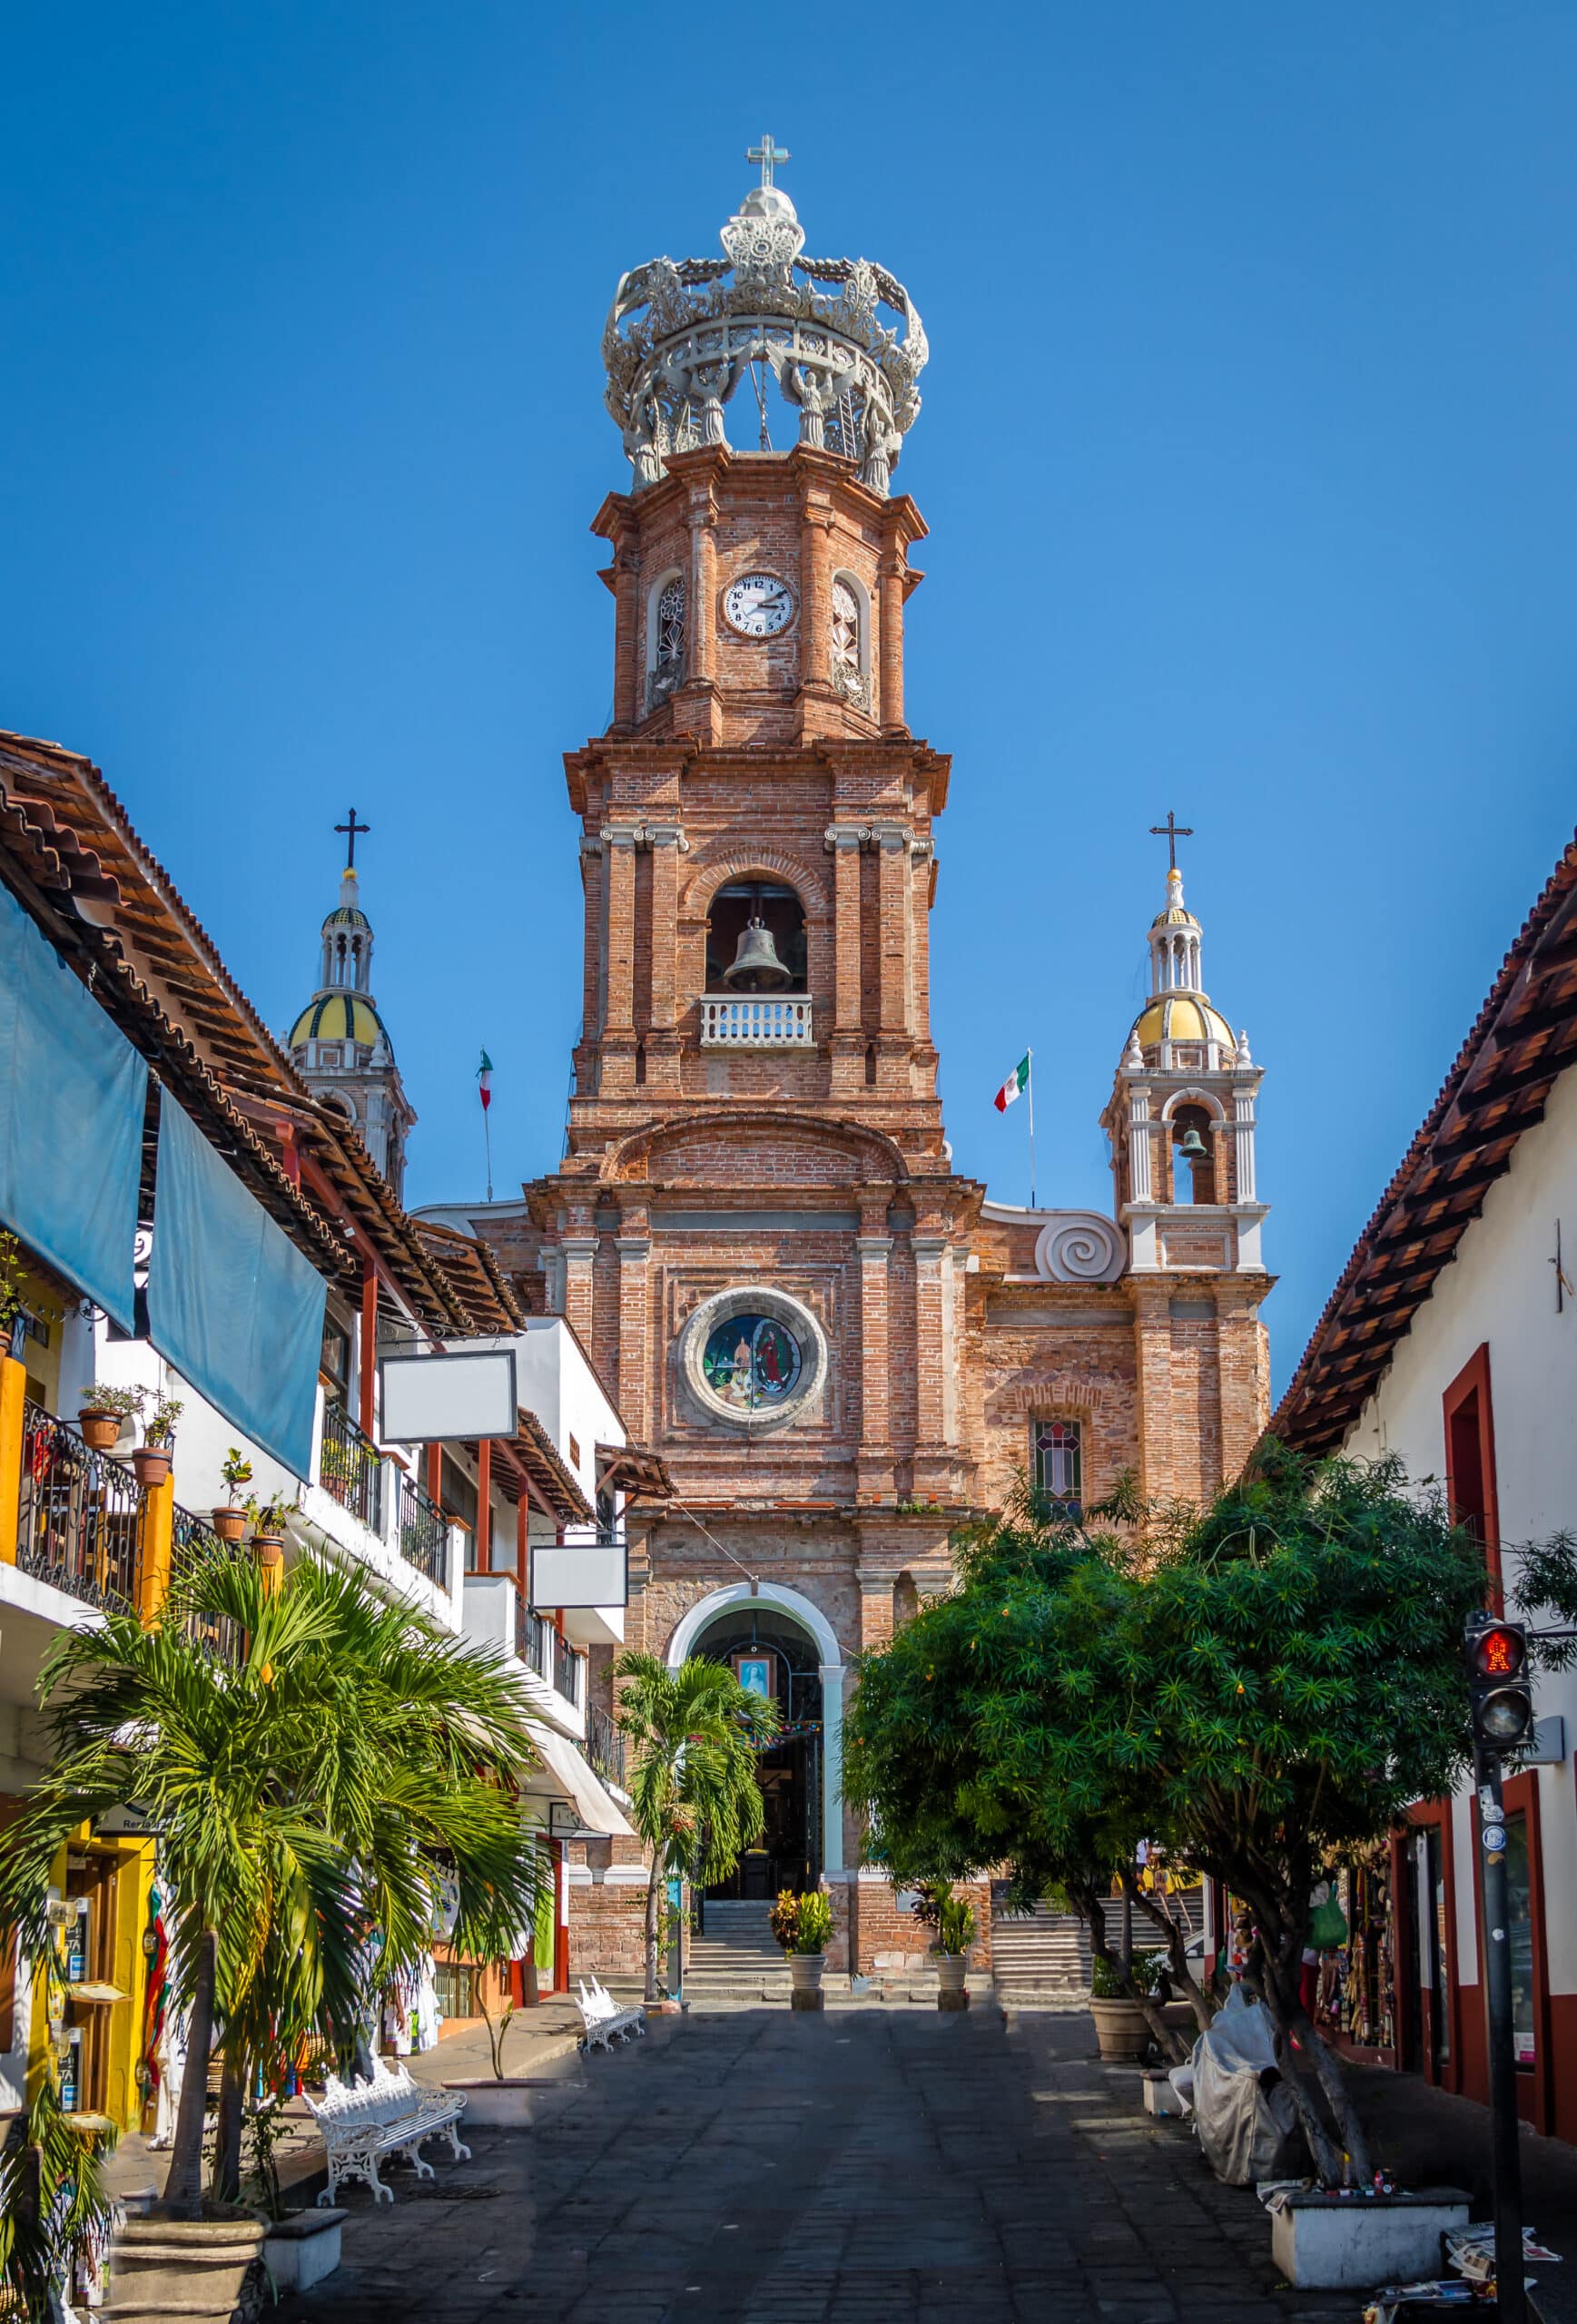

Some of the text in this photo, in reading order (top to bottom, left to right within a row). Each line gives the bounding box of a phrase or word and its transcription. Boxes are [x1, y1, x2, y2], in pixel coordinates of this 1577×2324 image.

[744, 582, 751, 590] 11
[754, 580, 764, 589] 12
[733, 592, 744, 600] 10
[732, 603, 738, 611] 9
[779, 603, 786, 611] 3
[774, 613, 782, 621] 4
[744, 622, 750, 630] 7
[755, 625, 763, 633] 6
